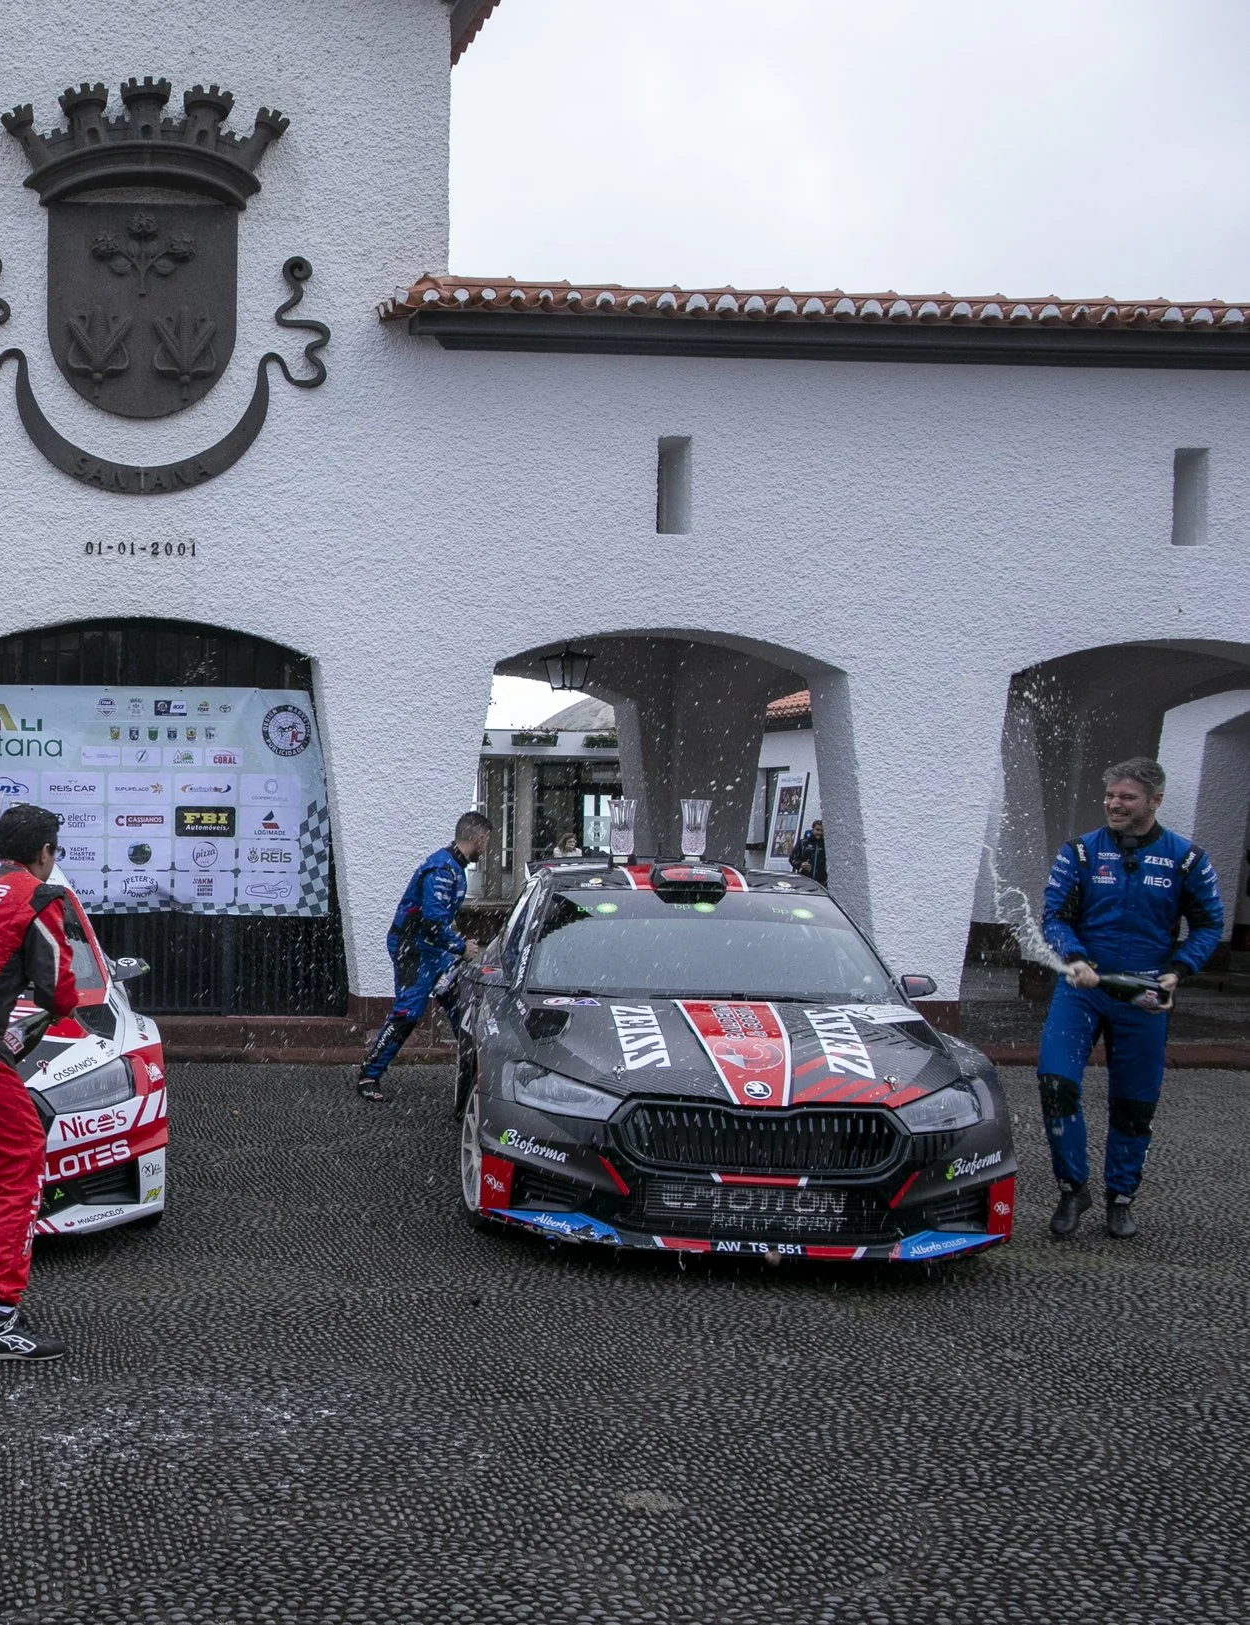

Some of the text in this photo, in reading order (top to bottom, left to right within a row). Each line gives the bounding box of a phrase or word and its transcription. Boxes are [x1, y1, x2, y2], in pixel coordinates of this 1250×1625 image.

[85, 541, 197, 556] 01-01-2001
[262, 708, 278, 731] DESIGN
[265, 739, 306, 756] PUBLICIDADE
[213, 756, 237, 765] CORAL
[67, 813, 96, 822] electro
[183, 812, 229, 824] FBI
[67, 821, 86, 829] som
[195, 847, 216, 861] pizza
[260, 852, 292, 863] REIS
[1144, 855, 1175, 869] ZEISS
[1143, 875, 1173, 888] MEO
[577, 904, 594, 913] bp
[673, 903, 691, 911] bp
[772, 906, 789, 915] bp
[609, 1005, 672, 1071] ZEISS
[52, 1057, 98, 1082] CASSIANO'S
[506, 1128, 567, 1163] Bioforma
[44, 1139, 131, 1182] LOTES
[952, 1150, 1002, 1177] Bioforma
[716, 1241, 802, 1255] AW TS 551
[909, 1241, 942, 1257] Alberto
